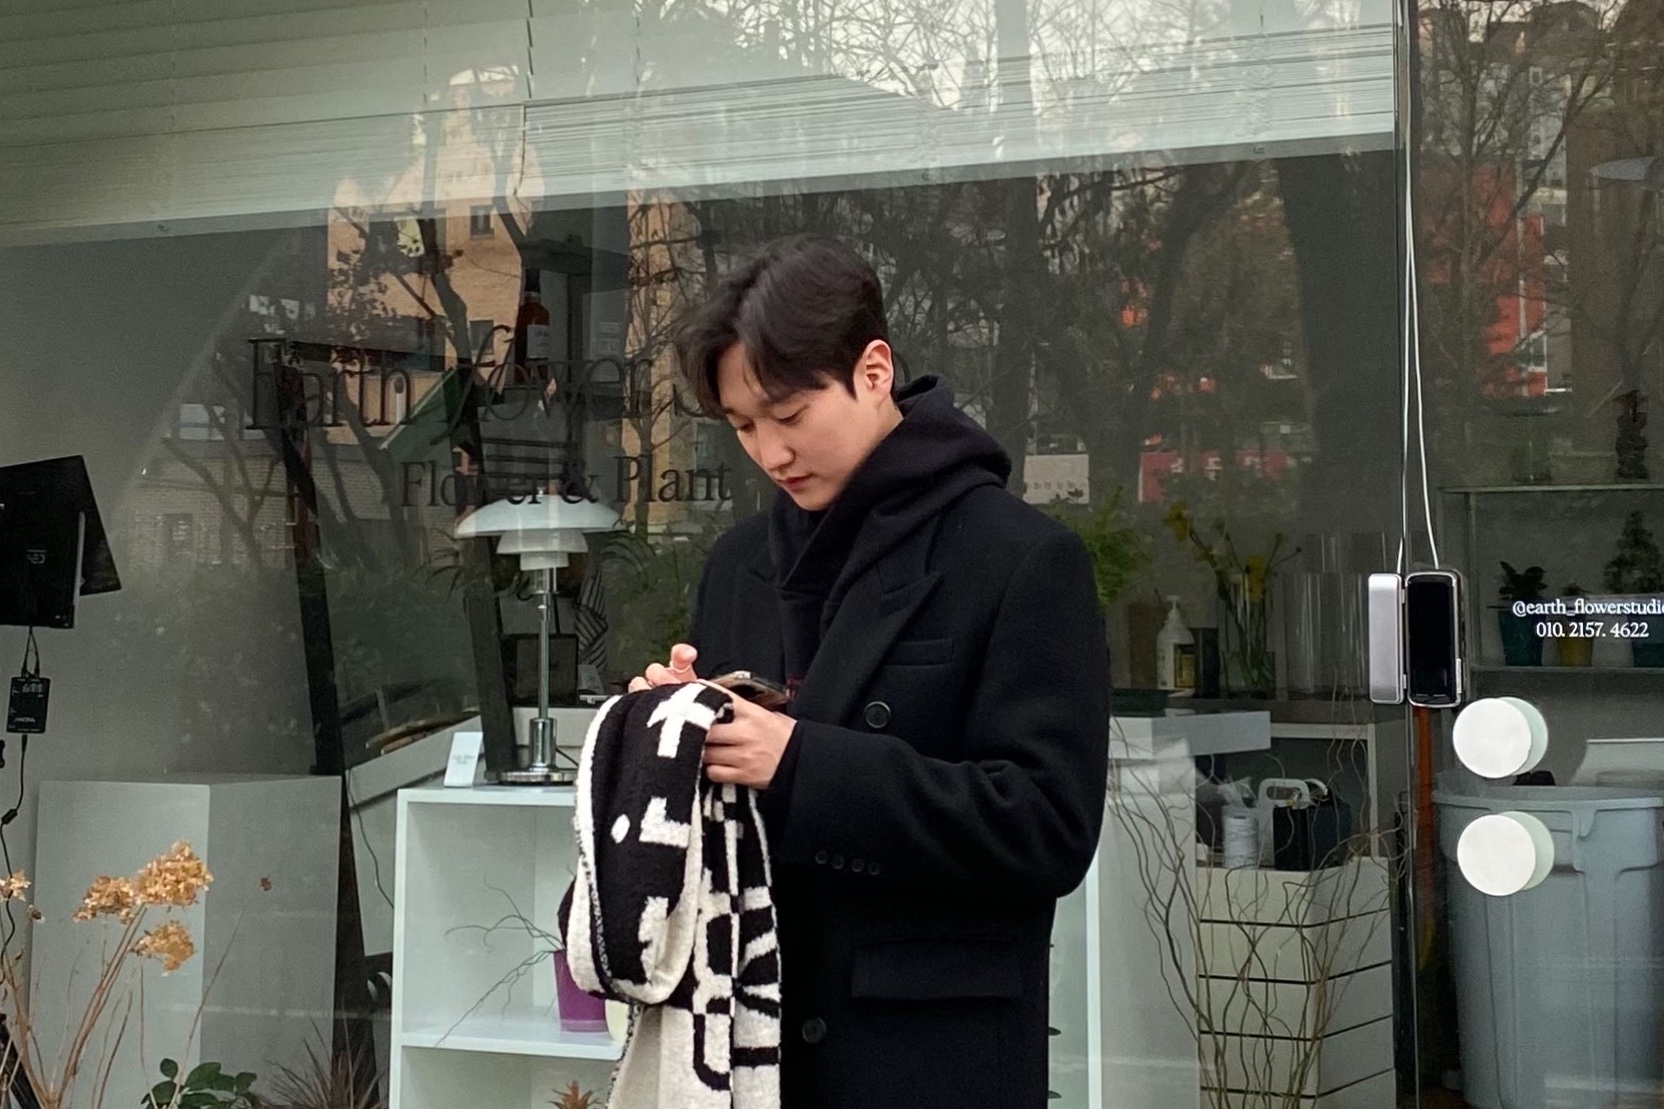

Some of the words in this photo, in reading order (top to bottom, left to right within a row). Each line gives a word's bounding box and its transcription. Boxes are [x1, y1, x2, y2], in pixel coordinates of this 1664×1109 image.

[247, 337, 413, 430] Earth
[401, 461, 549, 507] Flower
[558, 460, 599, 505] &
[614, 454, 732, 503] Plant
[1512, 598, 1664, 617] @earth_flowerstudi
[1536, 622, 1566, 638] 010.
[1569, 622, 1606, 638] 2157.
[1610, 622, 1649, 638] 4622
